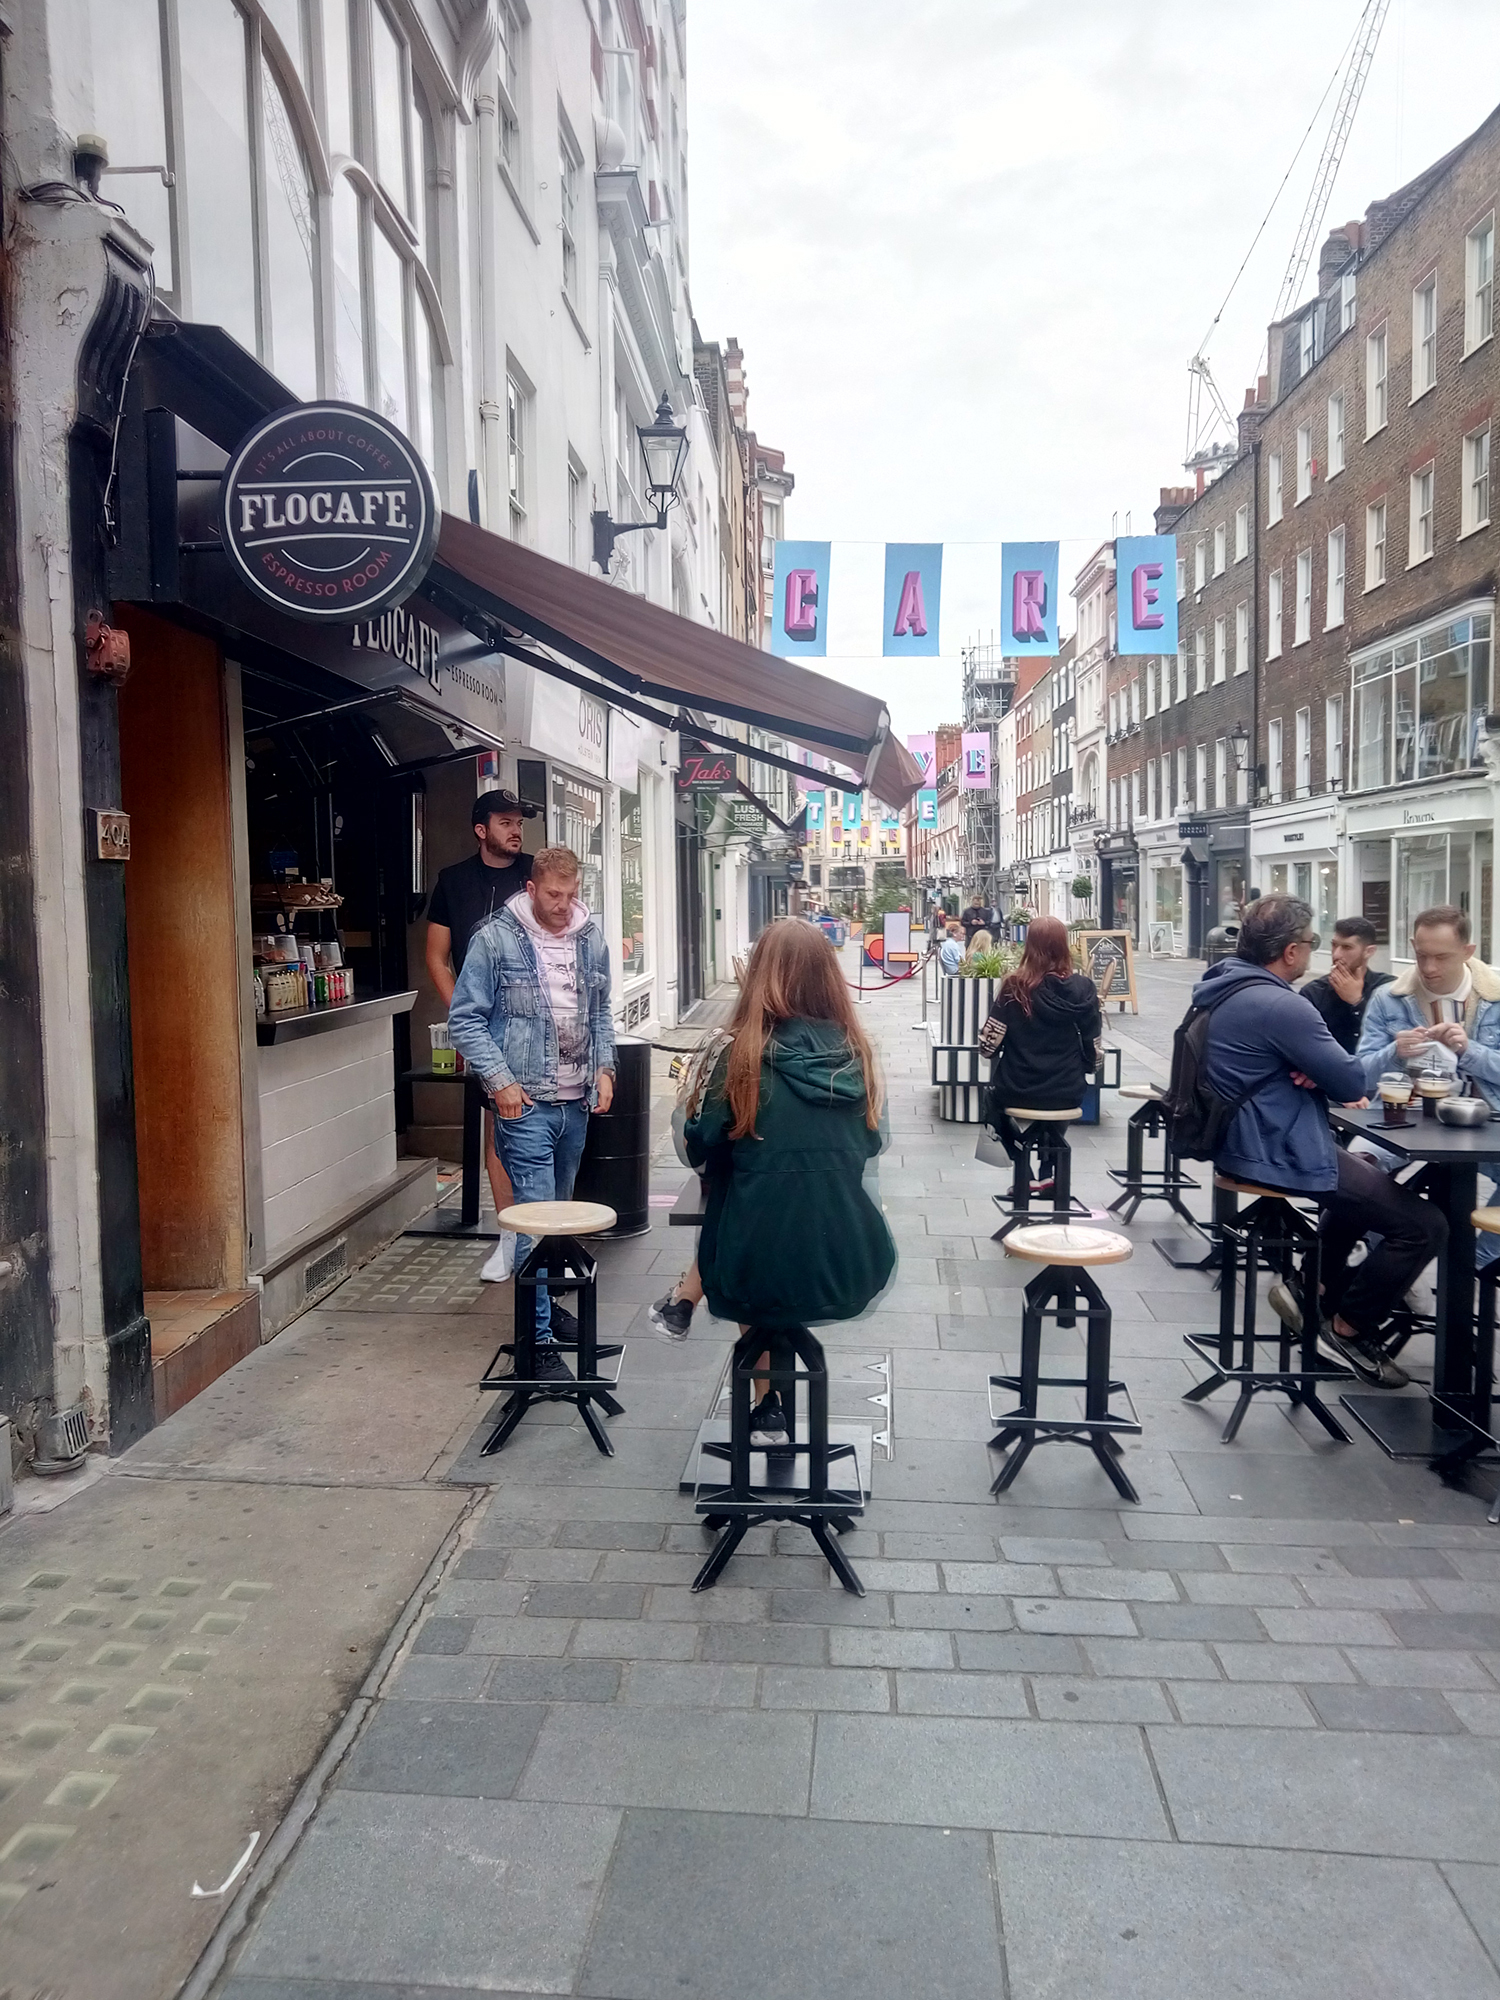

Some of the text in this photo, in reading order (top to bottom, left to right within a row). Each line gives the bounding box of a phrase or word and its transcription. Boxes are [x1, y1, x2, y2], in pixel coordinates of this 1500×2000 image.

[254, 430, 393, 475] IT'S ALL ABOUT COFFEE
[239, 490, 407, 532] FLOCAFE
[261, 550, 393, 597] ESPRESSO ROOM
[451, 665, 499, 706] ESPRESSO ROOM
[578, 695, 603, 748] ORIS
[678, 757, 732, 787] Jak's
[101, 823, 130, 847] 40A
[734, 813, 764, 822] FRESH
